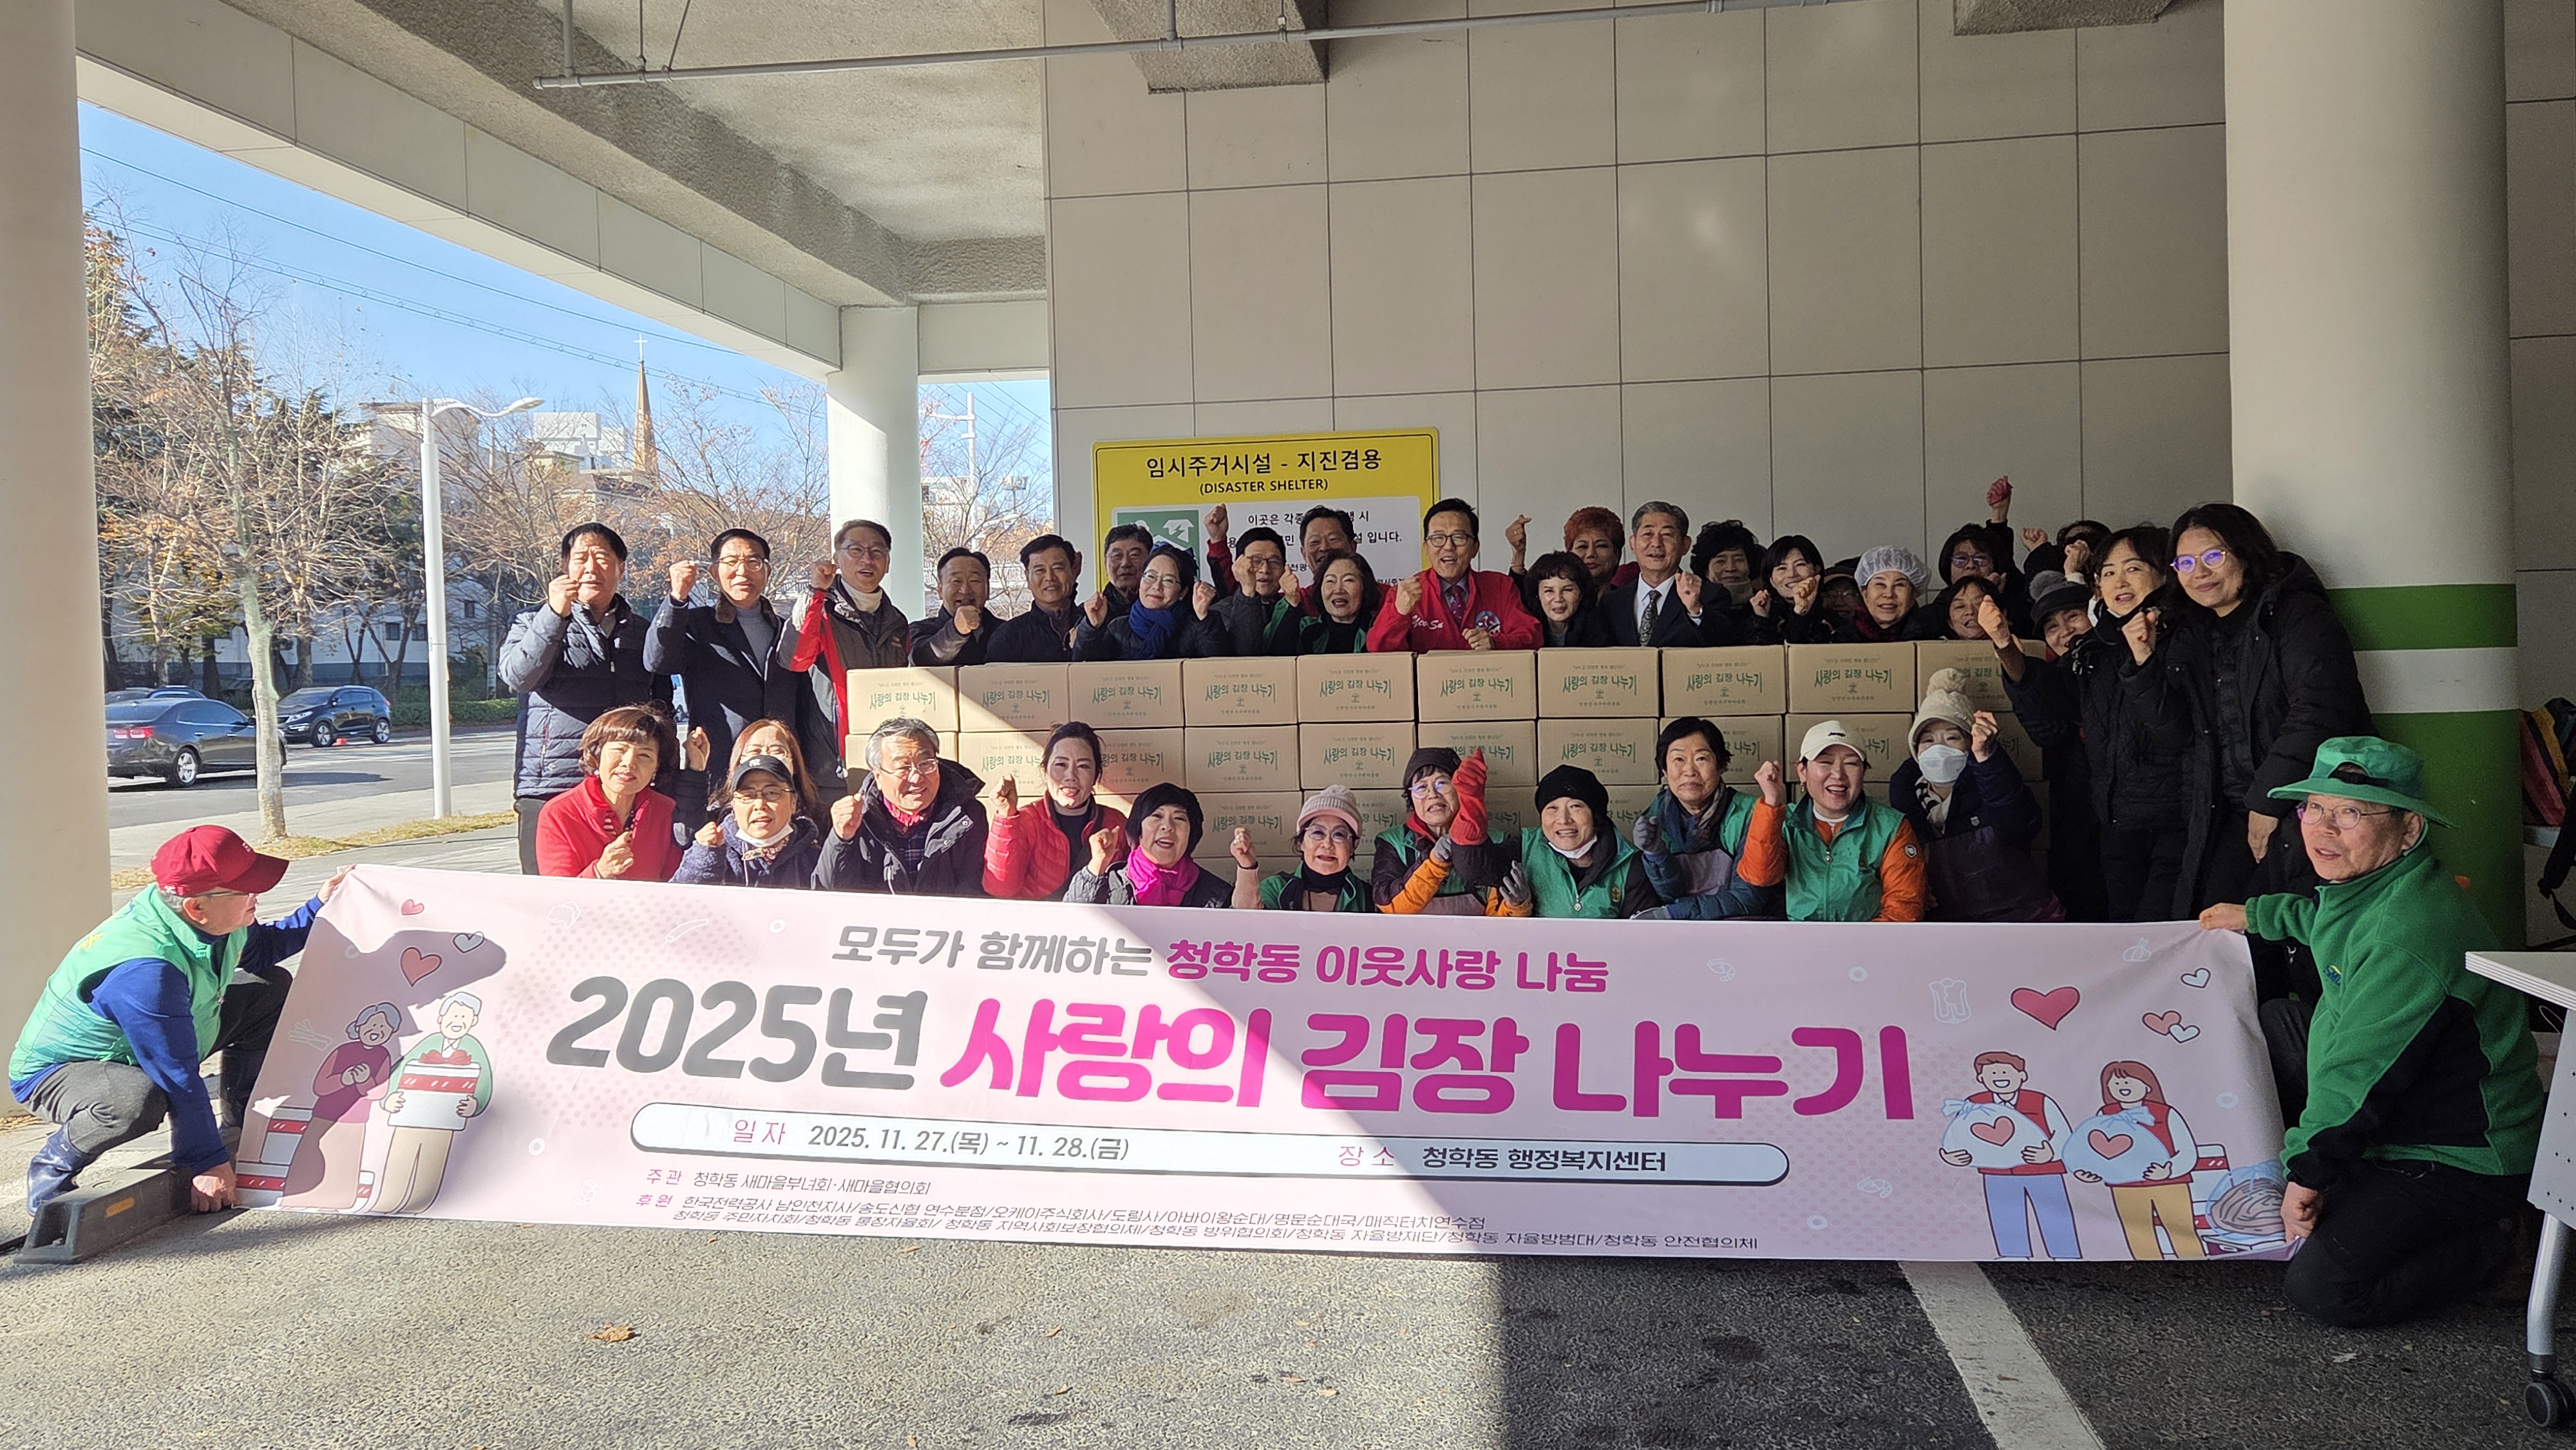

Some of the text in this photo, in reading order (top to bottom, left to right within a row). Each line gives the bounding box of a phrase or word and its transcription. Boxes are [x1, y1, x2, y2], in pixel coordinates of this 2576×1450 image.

[1146, 453, 1271, 478] 임시주거시설
[1297, 449, 1382, 472] 지진겸용
[1199, 478, 1329, 496] (DISASTER SHELTER)
[1248, 514, 1280, 526] 이곳은
[1359, 511, 1369, 523] 시
[1367, 531, 1403, 543] 입니다.
[1320, 679, 1391, 700] 사랑의 김장 나누기
[1441, 677, 1513, 699] 사랑의 김장 나누기
[1562, 674, 1637, 696] 사랑의 김장 나누기
[1686, 672, 1763, 693] 사랑의 김장 나누기
[1814, 668, 1892, 690] 사랑의 김장 나누기
[869, 690, 936, 711] 사랑의 김장 나누기
[981, 688, 1050, 710] 사랑의 김장 나누기
[1092, 685, 1162, 706] 사랑의 김장 나누기
[1206, 683, 1276, 704] 사랑의 김장 나누기
[1102, 751, 1164, 773] 랑의 김장 나누기
[1208, 749, 1278, 771] 사랑의 김장 나누기
[1323, 746, 1395, 767] 사랑의 김장 나누기
[1488, 744, 1513, 766] 나누기
[1561, 742, 1636, 764] 사랑의 김장 나누기
[1734, 740, 1760, 762] 나누기
[981, 757, 1004, 773] 사랑의
[1007, 756, 1023, 765] 김장
[831, 925, 1610, 993] 모두가 함께하는 청학동 이웃사랑 나눔
[545, 975, 1915, 1121] 2025년 사랑의 김장 나누기
[808, 1125, 869, 1149] 2025.
[880, 1129, 905, 1151] 11.
[914, 1130, 989, 1156] 27.(목)
[1016, 1135, 1043, 1156] 11.
[1052, 1136, 1130, 1162] 28.(금)
[1422, 1147, 1499, 1170] 청학동
[1508, 1148, 1666, 1173] 행정복지센터
[694, 1171, 739, 1188] 청학동
[682, 1196, 773, 1213] 한국전력공사
[1663, 1234, 1758, 1250] 안전협의체
